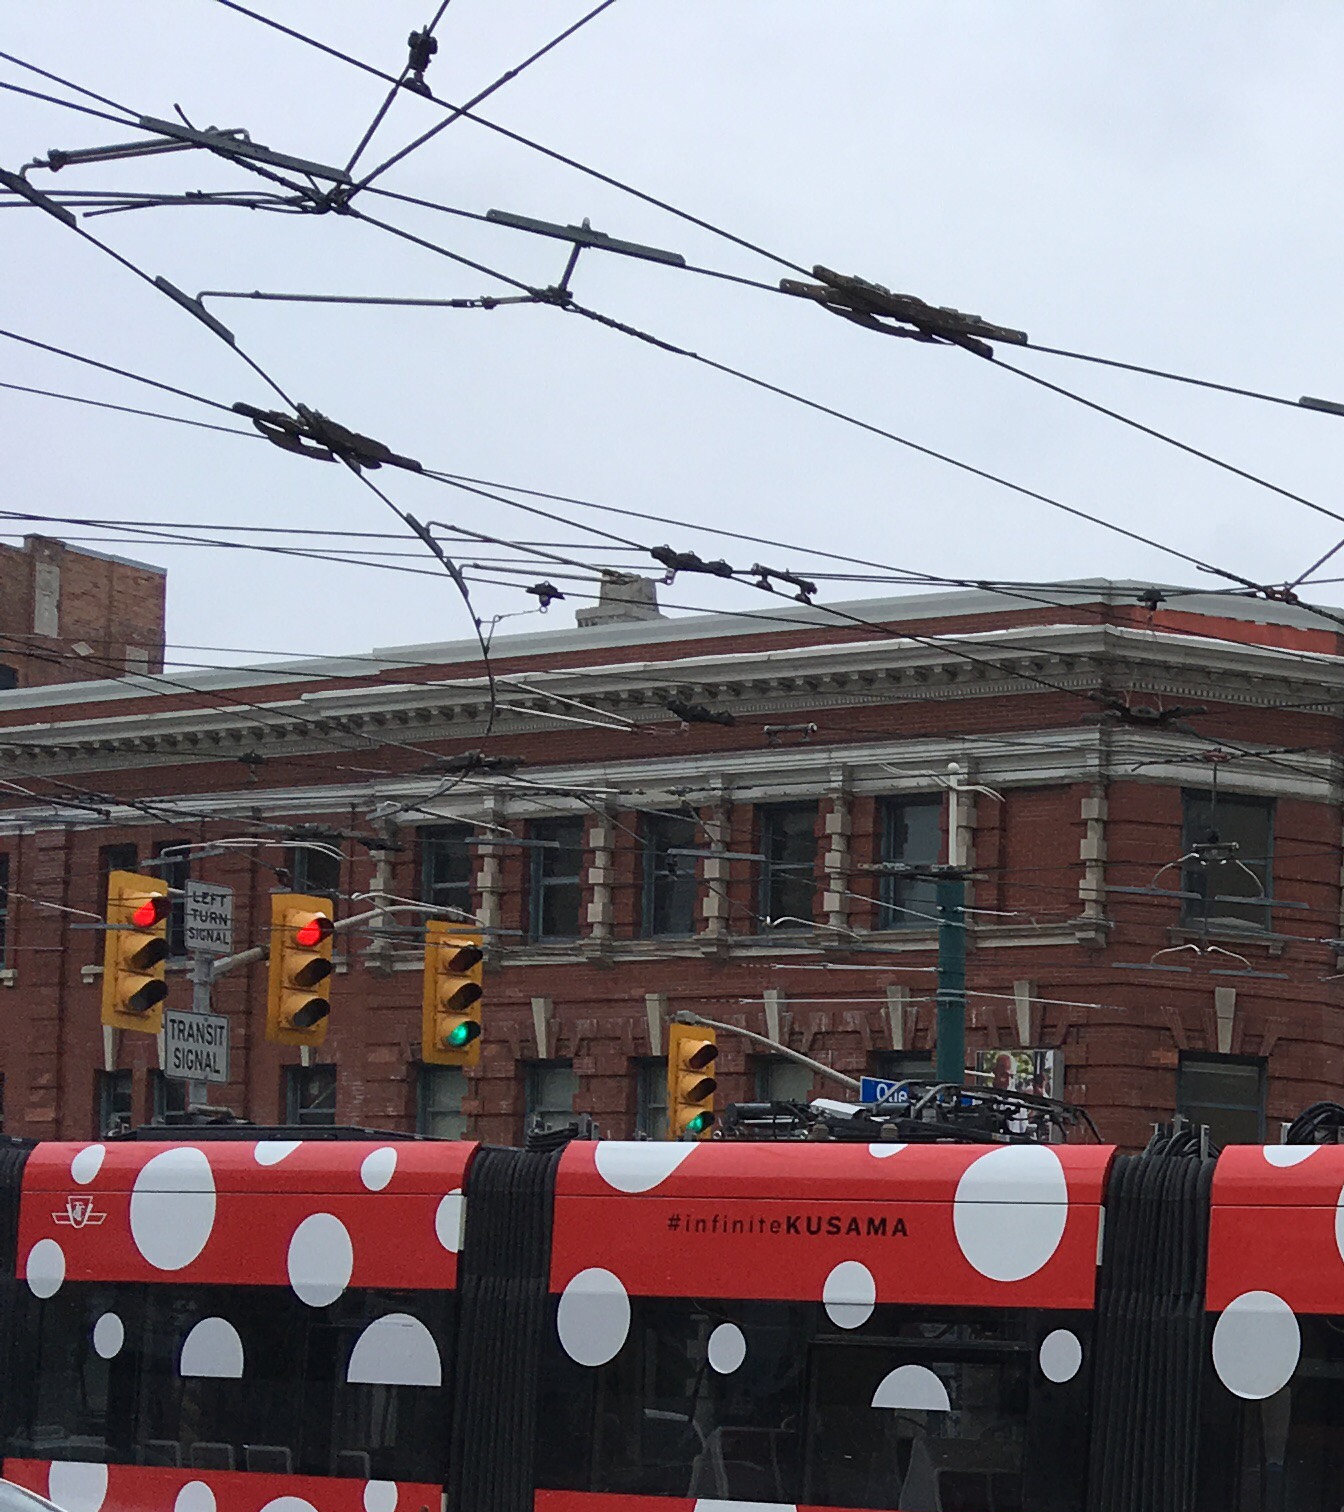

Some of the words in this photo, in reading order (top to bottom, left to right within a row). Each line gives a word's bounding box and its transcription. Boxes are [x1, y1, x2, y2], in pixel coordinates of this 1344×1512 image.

[192, 891, 227, 907] LEFT
[190, 909, 228, 927] TURN
[188, 927, 229, 945] SIGNAL
[169, 1018, 226, 1046] TRANSIT
[173, 1047, 221, 1074] SIGNAL
[667, 1214, 909, 1237] #infiniteKUSAMA
